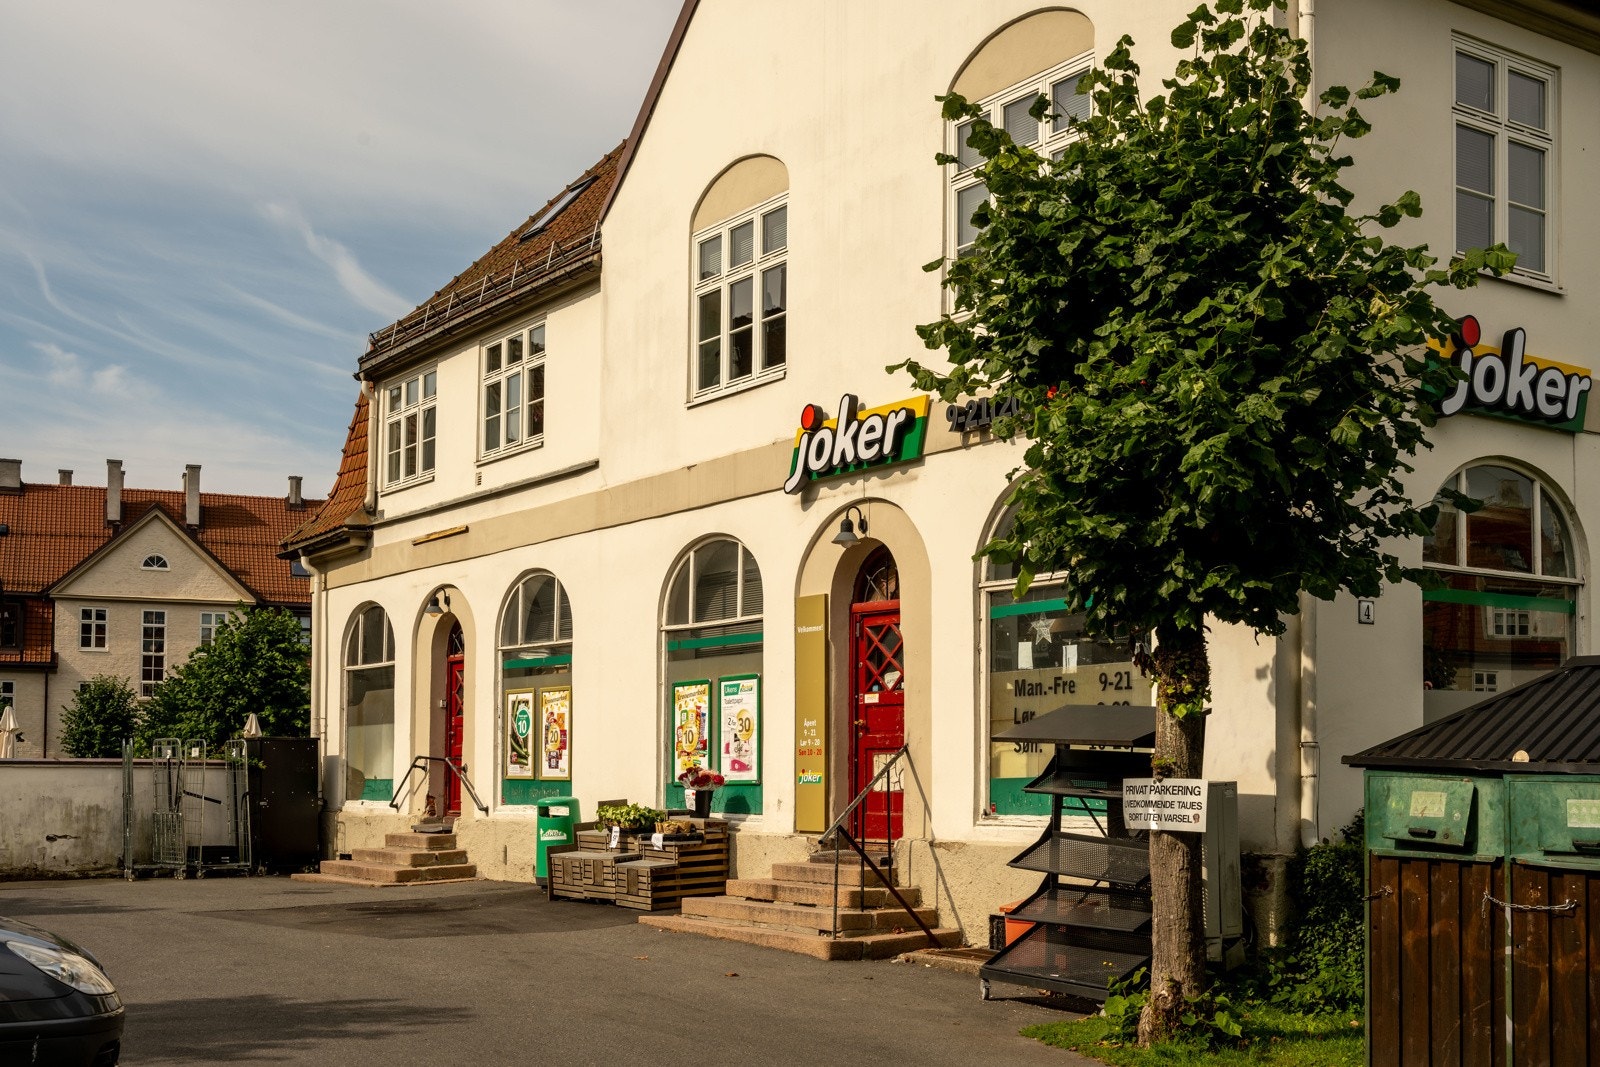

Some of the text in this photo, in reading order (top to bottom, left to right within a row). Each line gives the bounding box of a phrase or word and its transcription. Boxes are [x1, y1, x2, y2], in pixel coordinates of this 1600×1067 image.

[1439, 315, 1592, 420] joker
[946, 396, 990, 432] 9-21
[784, 393, 912, 494] joker
[1363, 604, 1371, 620] 4
[724, 685, 738, 694] Ukens
[1014, 671, 1133, 697] Man.-Fre 9-21
[803, 718, 817, 727] Åpent
[1013, 707, 1036, 725] Lør
[517, 721, 527, 734] 10
[727, 717, 732, 726] 2
[738, 717, 751, 733] 30
[549, 731, 559, 744] 20
[683, 729, 694, 744] 10
[799, 768, 821, 785] joker
[1125, 785, 1201, 796] PRIVAT PARKERING
[1124, 800, 1203, 810] VEDKOMMENDE TAUES
[1143, 813, 1162, 822] UTEN
[1163, 814, 1193, 824] VARSEL
